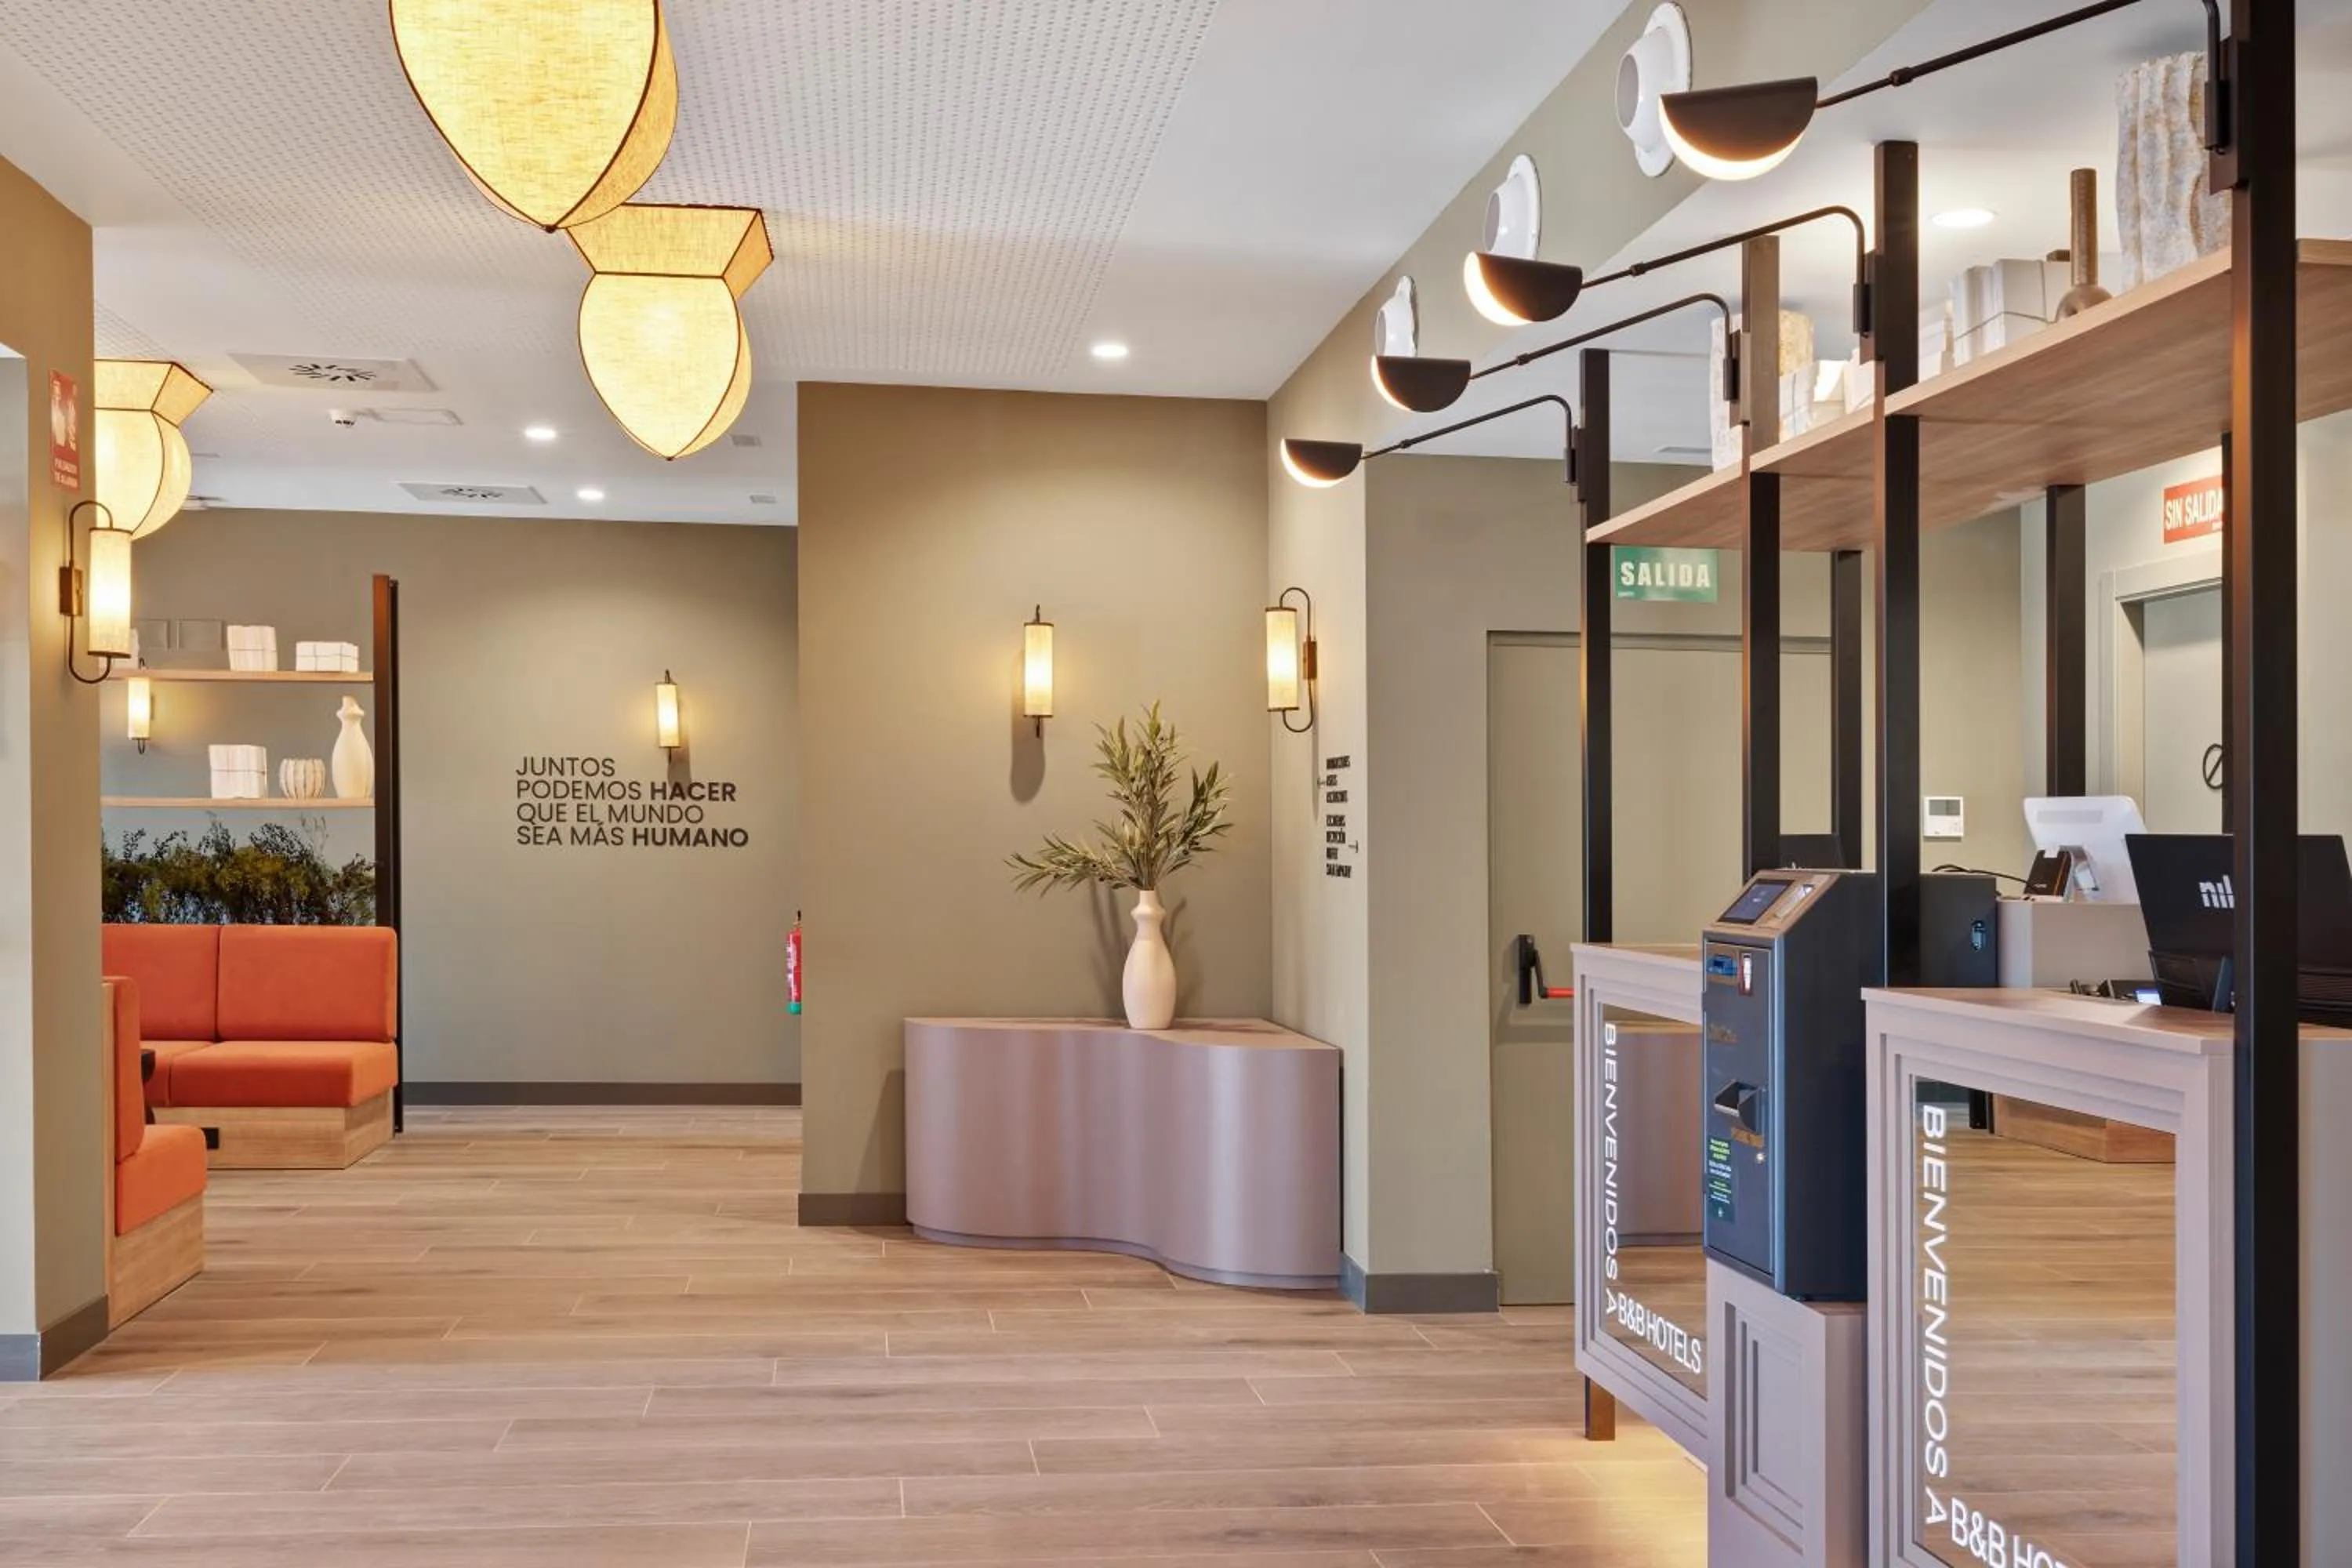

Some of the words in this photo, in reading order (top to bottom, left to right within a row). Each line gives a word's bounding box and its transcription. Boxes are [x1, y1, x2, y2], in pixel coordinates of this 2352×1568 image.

[2165, 497, 2183, 530] SIN
[2185, 488, 2222, 527] SALIDA
[1621, 561, 1711, 588] SALIDA
[515, 757, 615, 777] JUNTOS
[517, 780, 641, 800] PODEMOS
[650, 782, 736, 802] HACER
[517, 803, 567, 824] QUE
[576, 804, 600, 822] EL
[608, 804, 703, 824] MUNDO
[517, 826, 563, 845] SEA
[570, 822, 625, 846] MÁS
[633, 827, 749, 848] HUMANO
[1605, 1023, 1617, 1281] BIENVENIDOS
[1606, 1287, 1617, 1315] A
[1923, 1104, 1947, 1479] BIENVENIDOS
[1617, 1292, 1645, 1337] B&B
[1646, 1308, 1702, 1374] HOTELS
[1925, 1486, 1947, 1525] A
[1951, 1497, 2006, 1568] B&B
